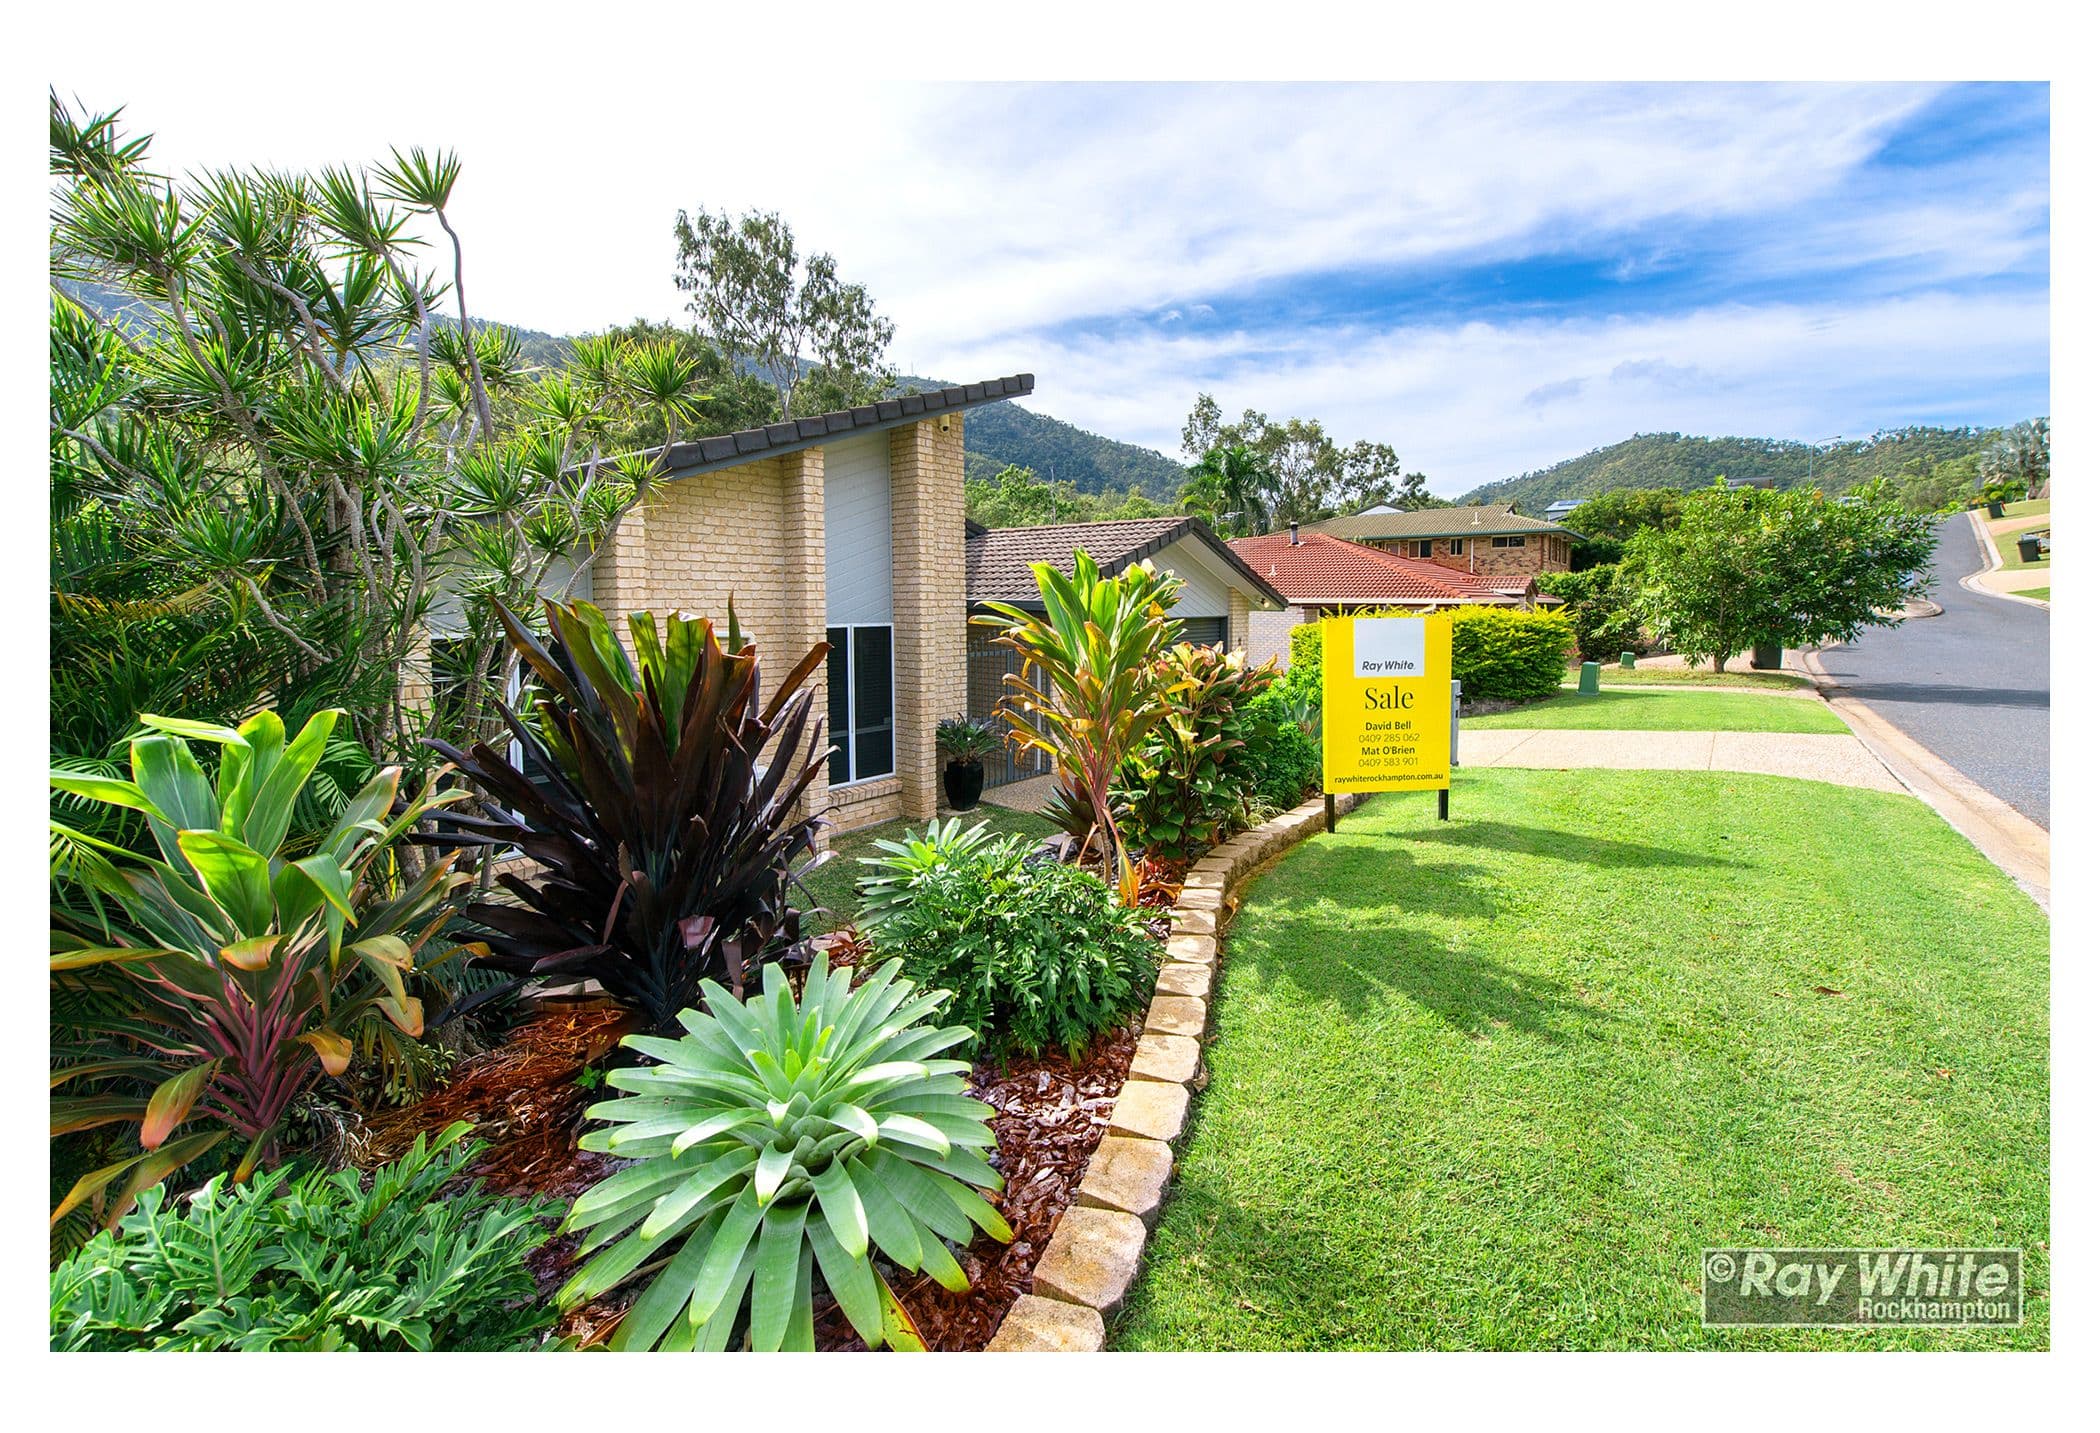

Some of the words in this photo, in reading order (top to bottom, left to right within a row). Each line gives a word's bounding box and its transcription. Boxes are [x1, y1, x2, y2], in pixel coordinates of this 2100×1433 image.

[1362, 660, 1383, 672] Ray
[1385, 660, 1415, 671] White
[1364, 685, 1414, 710] Sale
[1365, 721, 1392, 731] David
[1394, 720, 1412, 731] Bell
[1358, 733, 1382, 743] 0409
[1383, 733, 1401, 743] 285
[1402, 732, 1420, 742] 062
[1361, 746, 1380, 756] Mat
[1382, 745, 1416, 755] O'Brien
[1358, 758, 1382, 768] 0409
[1383, 758, 1401, 767] 583
[1402, 757, 1419, 767] 901
[1334, 772, 1444, 784] raywhiterockhampton.com.au
